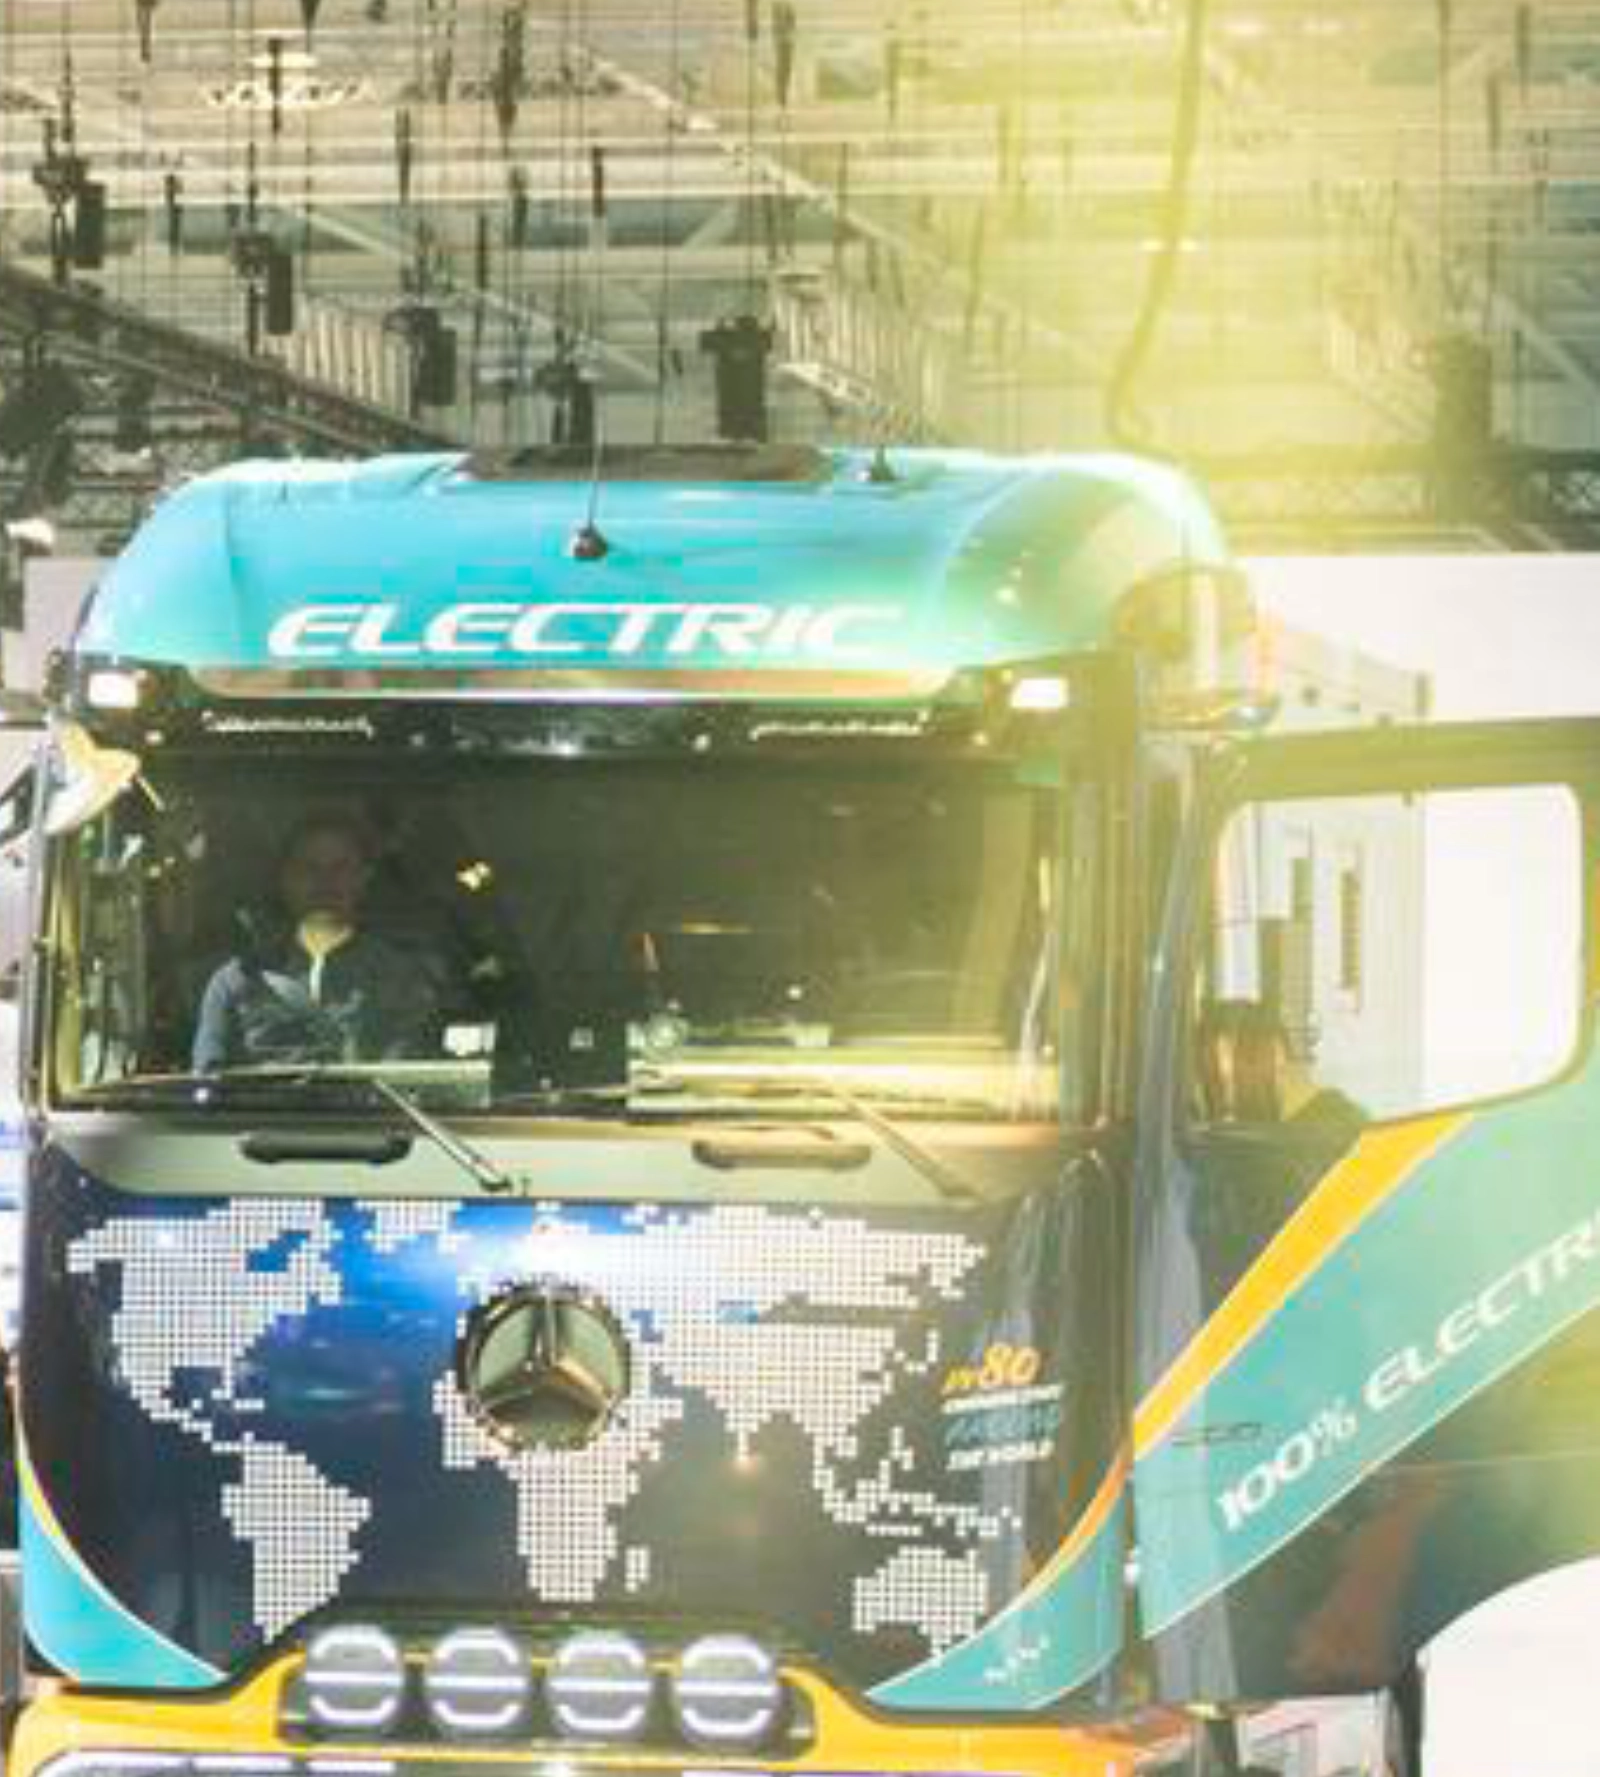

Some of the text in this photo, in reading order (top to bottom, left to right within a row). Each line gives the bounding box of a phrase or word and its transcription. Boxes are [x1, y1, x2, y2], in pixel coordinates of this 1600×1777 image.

[265, 601, 906, 660] ELECTRIC
[1214, 1206, 1600, 1534] 100% ELECTR
